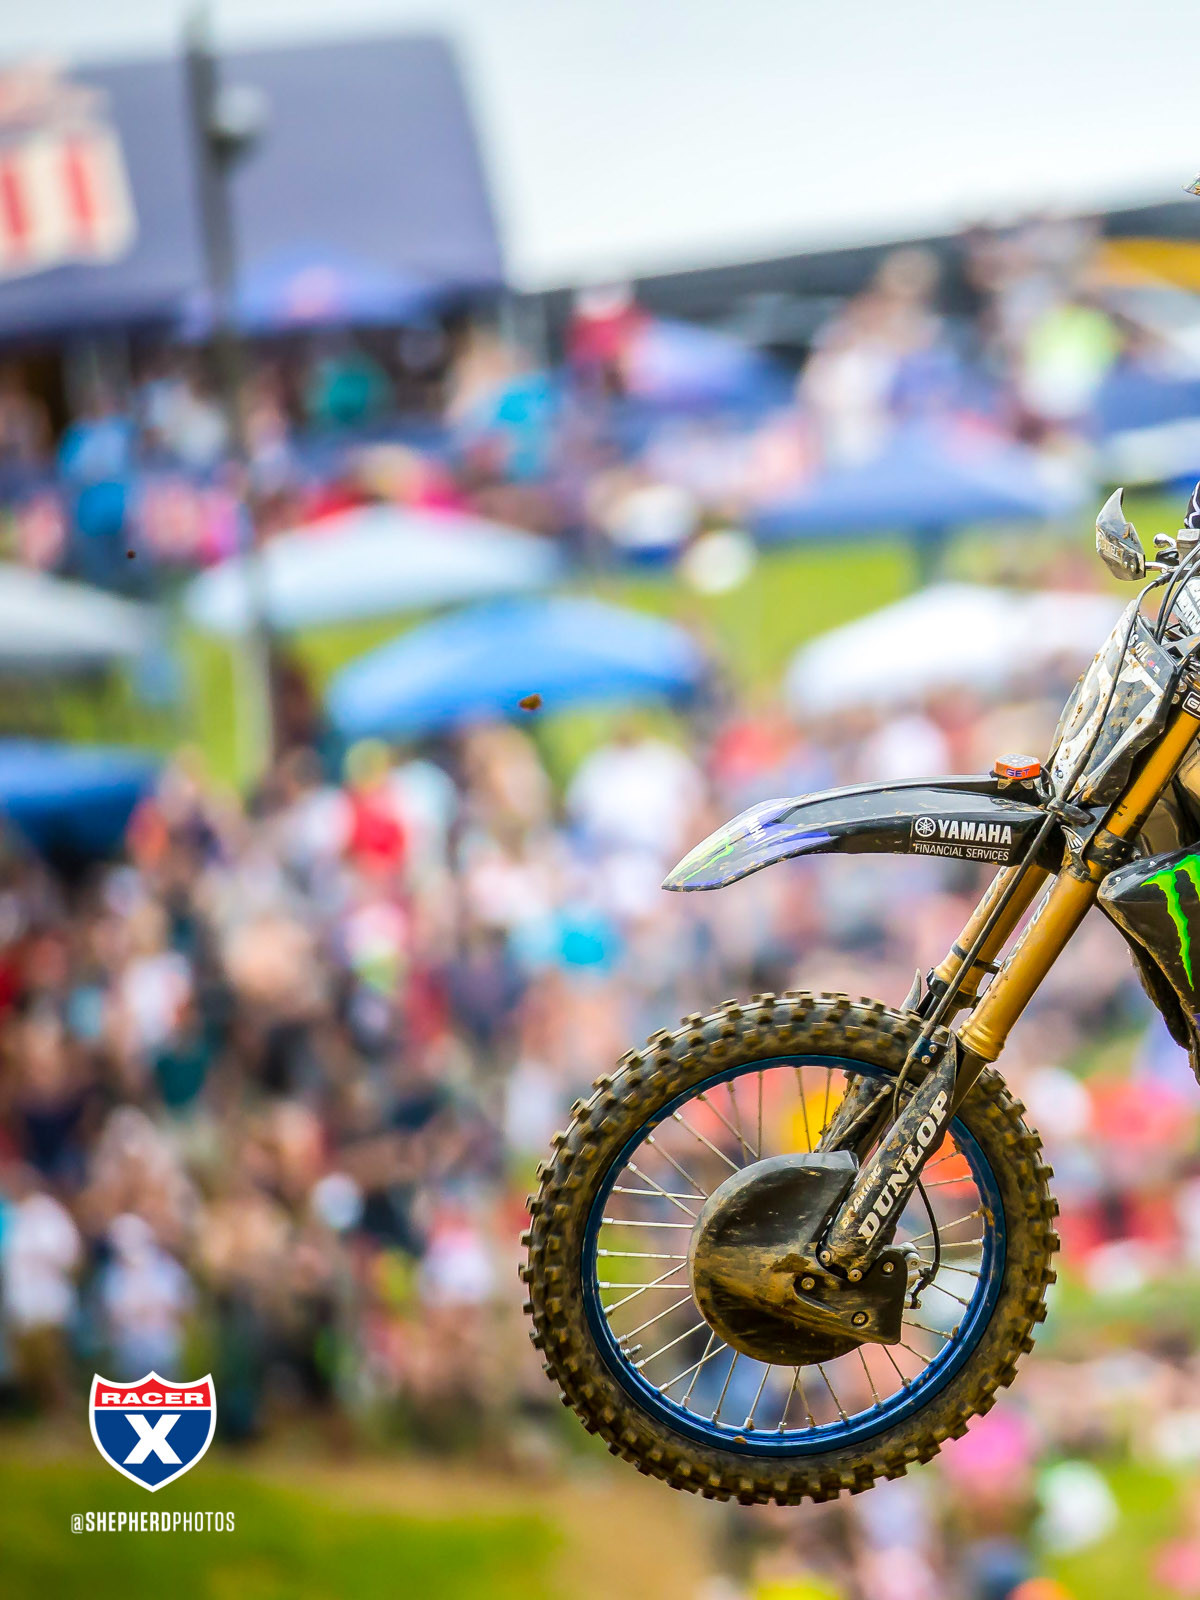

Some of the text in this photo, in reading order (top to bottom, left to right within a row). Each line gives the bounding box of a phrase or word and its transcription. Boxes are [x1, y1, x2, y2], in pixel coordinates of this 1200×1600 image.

[1005, 768, 1030, 777] GET
[938, 819, 1012, 844] YAMAHA
[915, 843, 1009, 861] FINANCIAL SERVICES
[858, 1090, 948, 1245] DUNLOP
